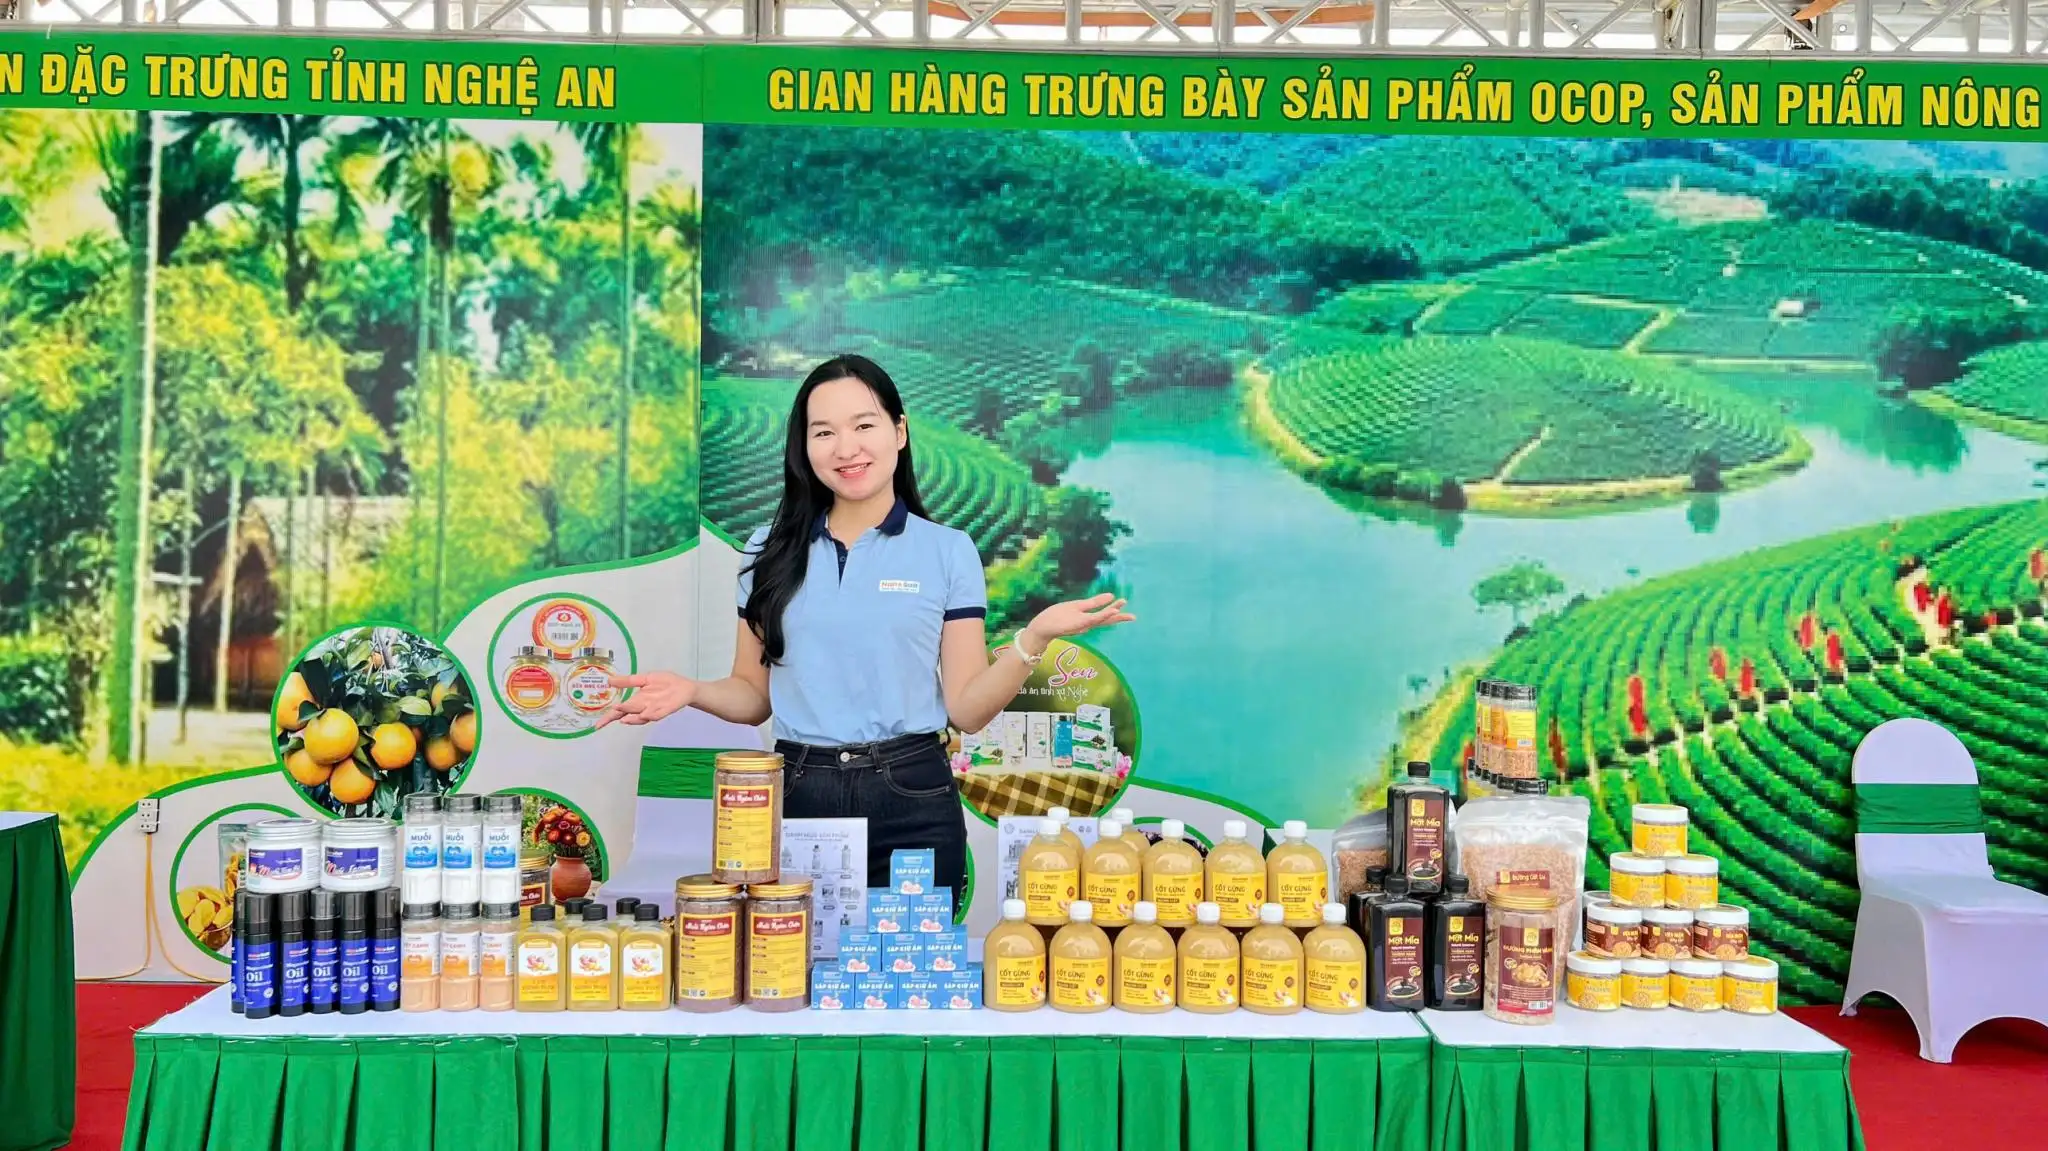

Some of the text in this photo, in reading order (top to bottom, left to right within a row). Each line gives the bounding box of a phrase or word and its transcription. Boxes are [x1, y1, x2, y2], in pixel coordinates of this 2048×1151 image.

[0, 45, 616, 115] N ĐẶC TRƯNG TỈNH NGHỆ AN
[768, 63, 2042, 130] GIAN HÀNG TRƯNG BÀY SẢN PHẨM OCOP, SẢN PHẨM NÔNG
[1048, 646, 1097, 686] Sen
[286, 968, 304, 979] Oil
[313, 967, 331, 977] Oil
[343, 966, 360, 977] Oil
[372, 965, 388, 975] Oil
[246, 971, 263, 982] Oil
